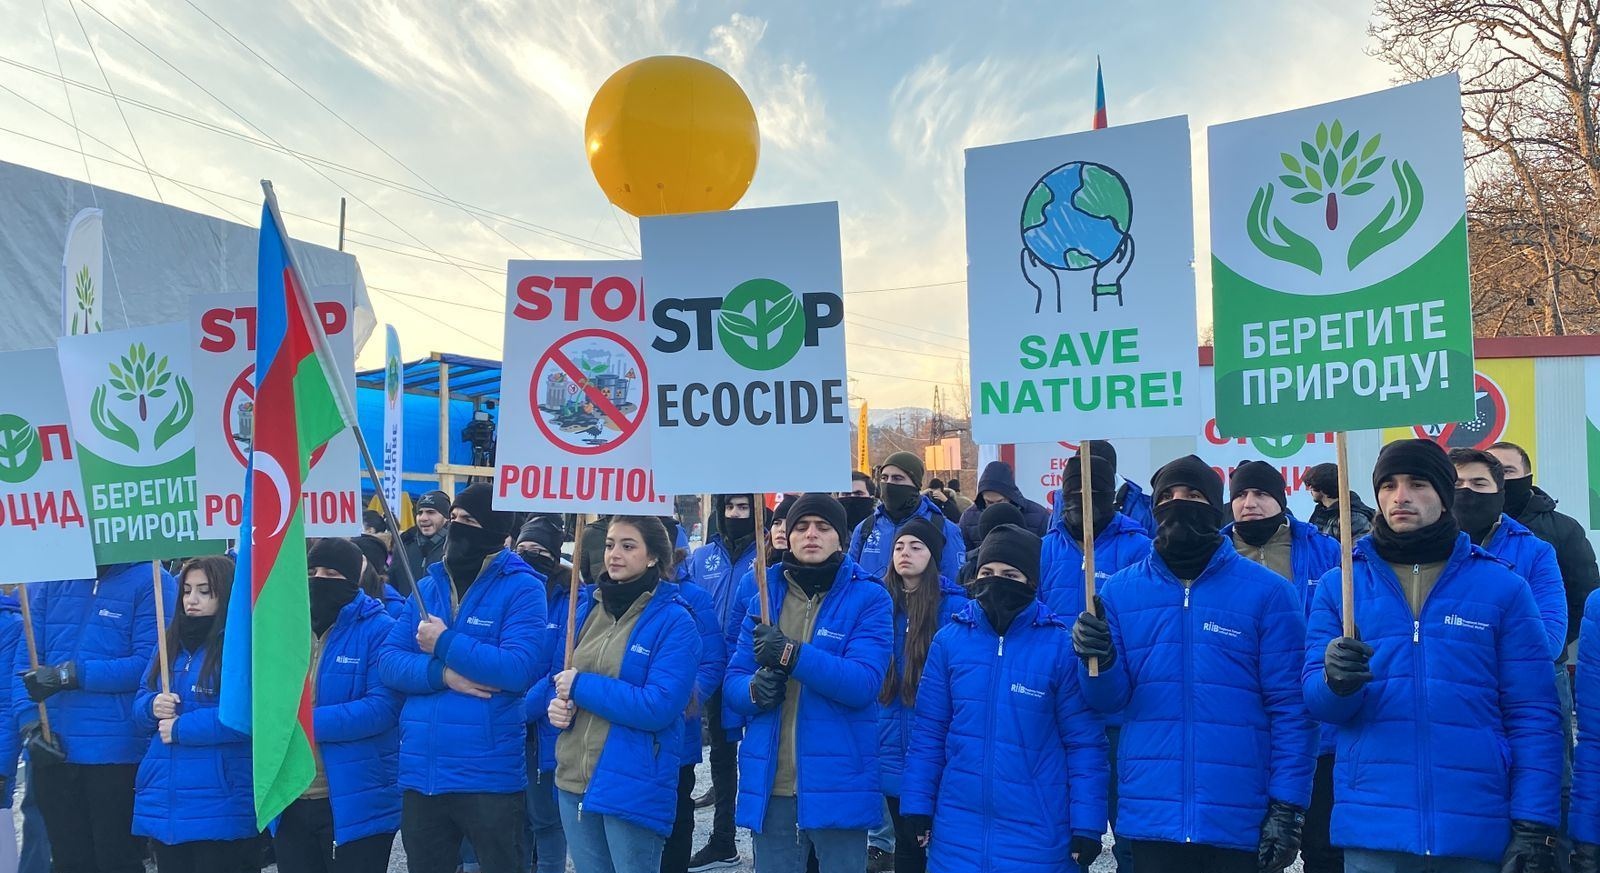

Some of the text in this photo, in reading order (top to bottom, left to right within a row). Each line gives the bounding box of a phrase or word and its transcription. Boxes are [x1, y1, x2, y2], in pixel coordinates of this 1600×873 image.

[512, 275, 646, 323] STO
[200, 301, 347, 353] STP
[651, 278, 844, 372] STOP
[1019, 327, 1140, 370] SAVE
[1242, 299, 1448, 360] БЕРЕГИТЕ
[980, 371, 1183, 415] NATURE!
[1242, 349, 1450, 406] ПРИРОДУ!
[657, 379, 844, 428] ECOCIDE
[92, 476, 197, 511] БЕРЕГИТ
[94, 509, 200, 544] ПРИРОД
